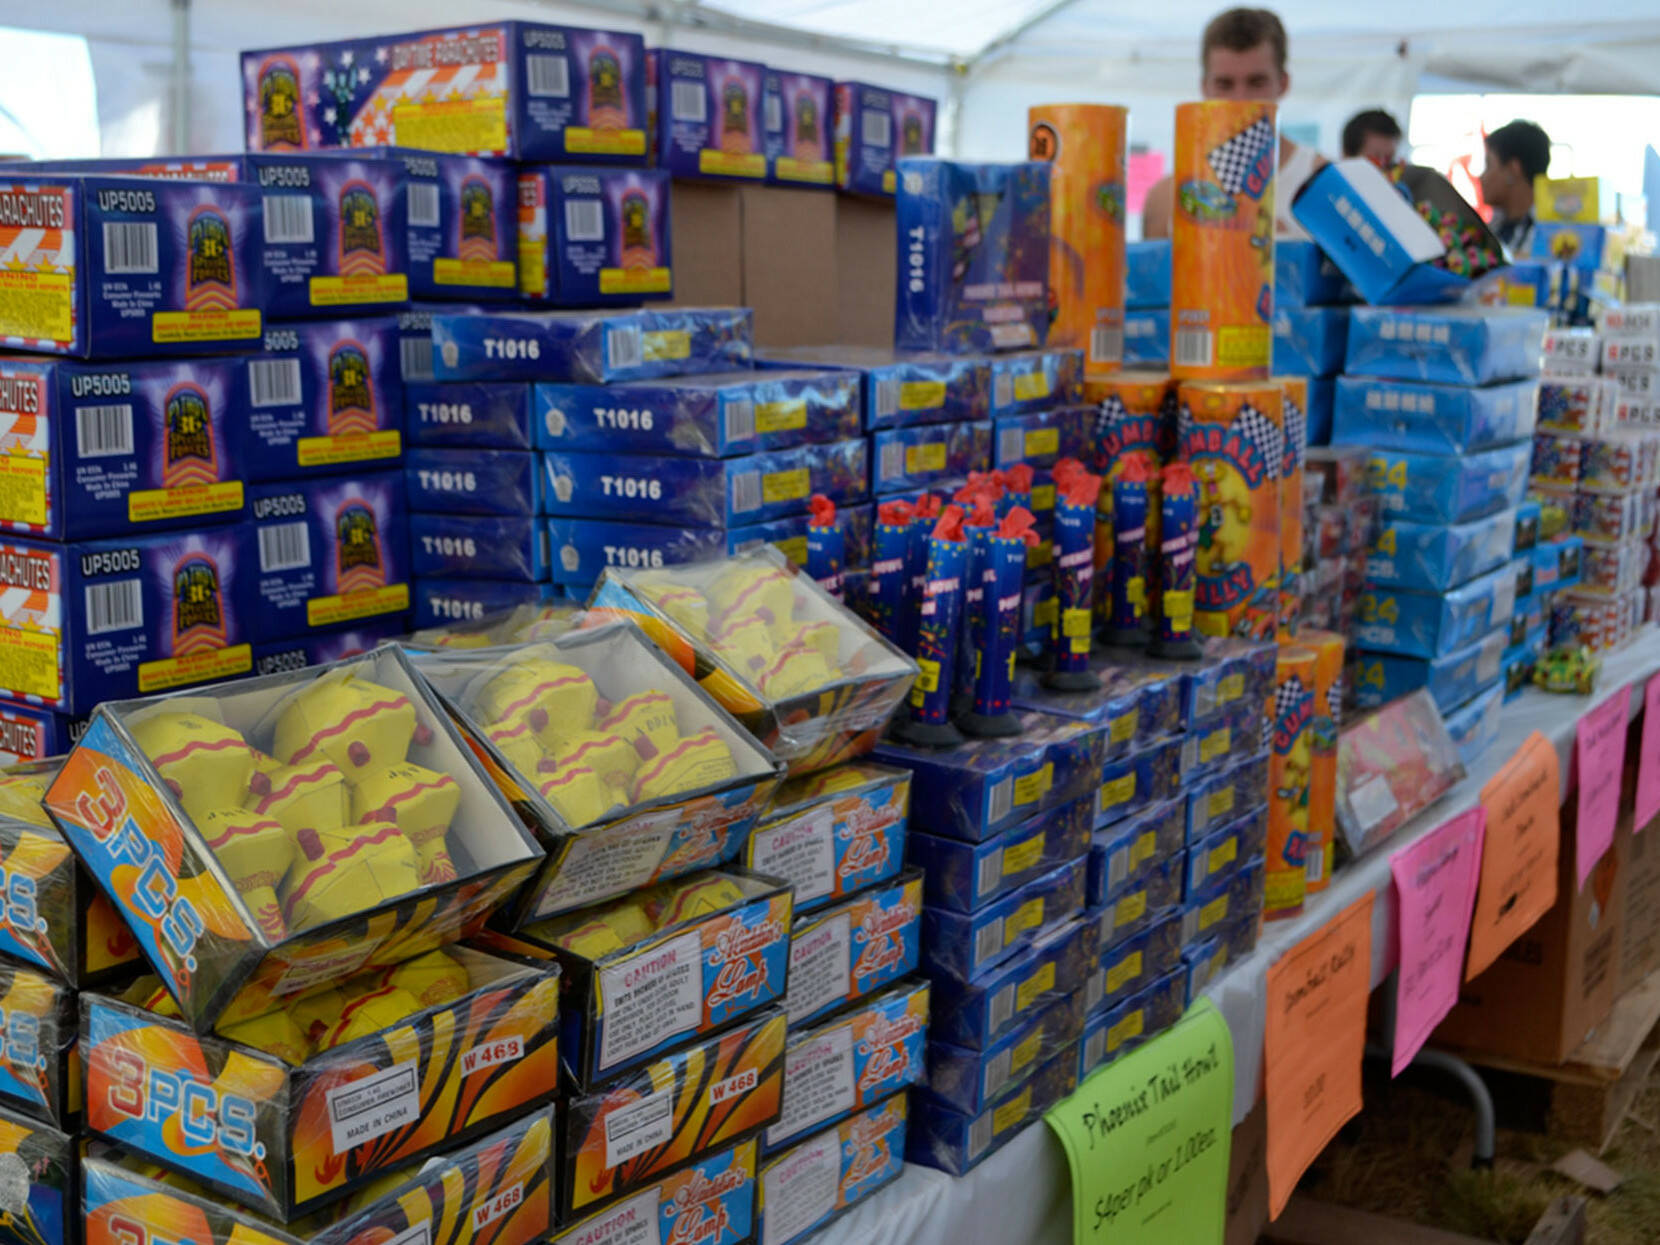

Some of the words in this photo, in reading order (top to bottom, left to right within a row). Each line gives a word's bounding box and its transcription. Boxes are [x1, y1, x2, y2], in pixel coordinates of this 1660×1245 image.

[99, 190, 156, 213] UP5005
[909, 226, 925, 294] T1016
[484, 339, 540, 360] T1016
[72, 374, 131, 398] UP5005
[418, 404, 472, 424] T1016
[594, 408, 653, 430] T1016
[418, 470, 477, 492] T1016
[601, 476, 661, 500] T1016
[254, 494, 306, 518] UP5005
[421, 536, 476, 557] T1016
[604, 545, 663, 569] T1016
[82, 549, 141, 576] UP5005
[431, 597, 484, 620] T1016
[772, 823, 814, 851] CAUTION
[76, 766, 205, 974] 3PCS.
[0, 866, 49, 935] S.
[793, 930, 832, 962] CAUTION
[624, 949, 677, 988] CAUTION
[0, 1005, 47, 1070] S.
[463, 1054, 477, 1072] W
[712, 1085, 726, 1101] W
[728, 1073, 756, 1094] 468
[107, 1045, 267, 1161] 3PCS.
[346, 1121, 370, 1140] MADE
[372, 1116, 382, 1129] IN
[384, 1105, 408, 1124] CHINA
[475, 1207, 490, 1225] W
[494, 1187, 522, 1213] 468
[575, 1208, 637, 1245] CAUTION
